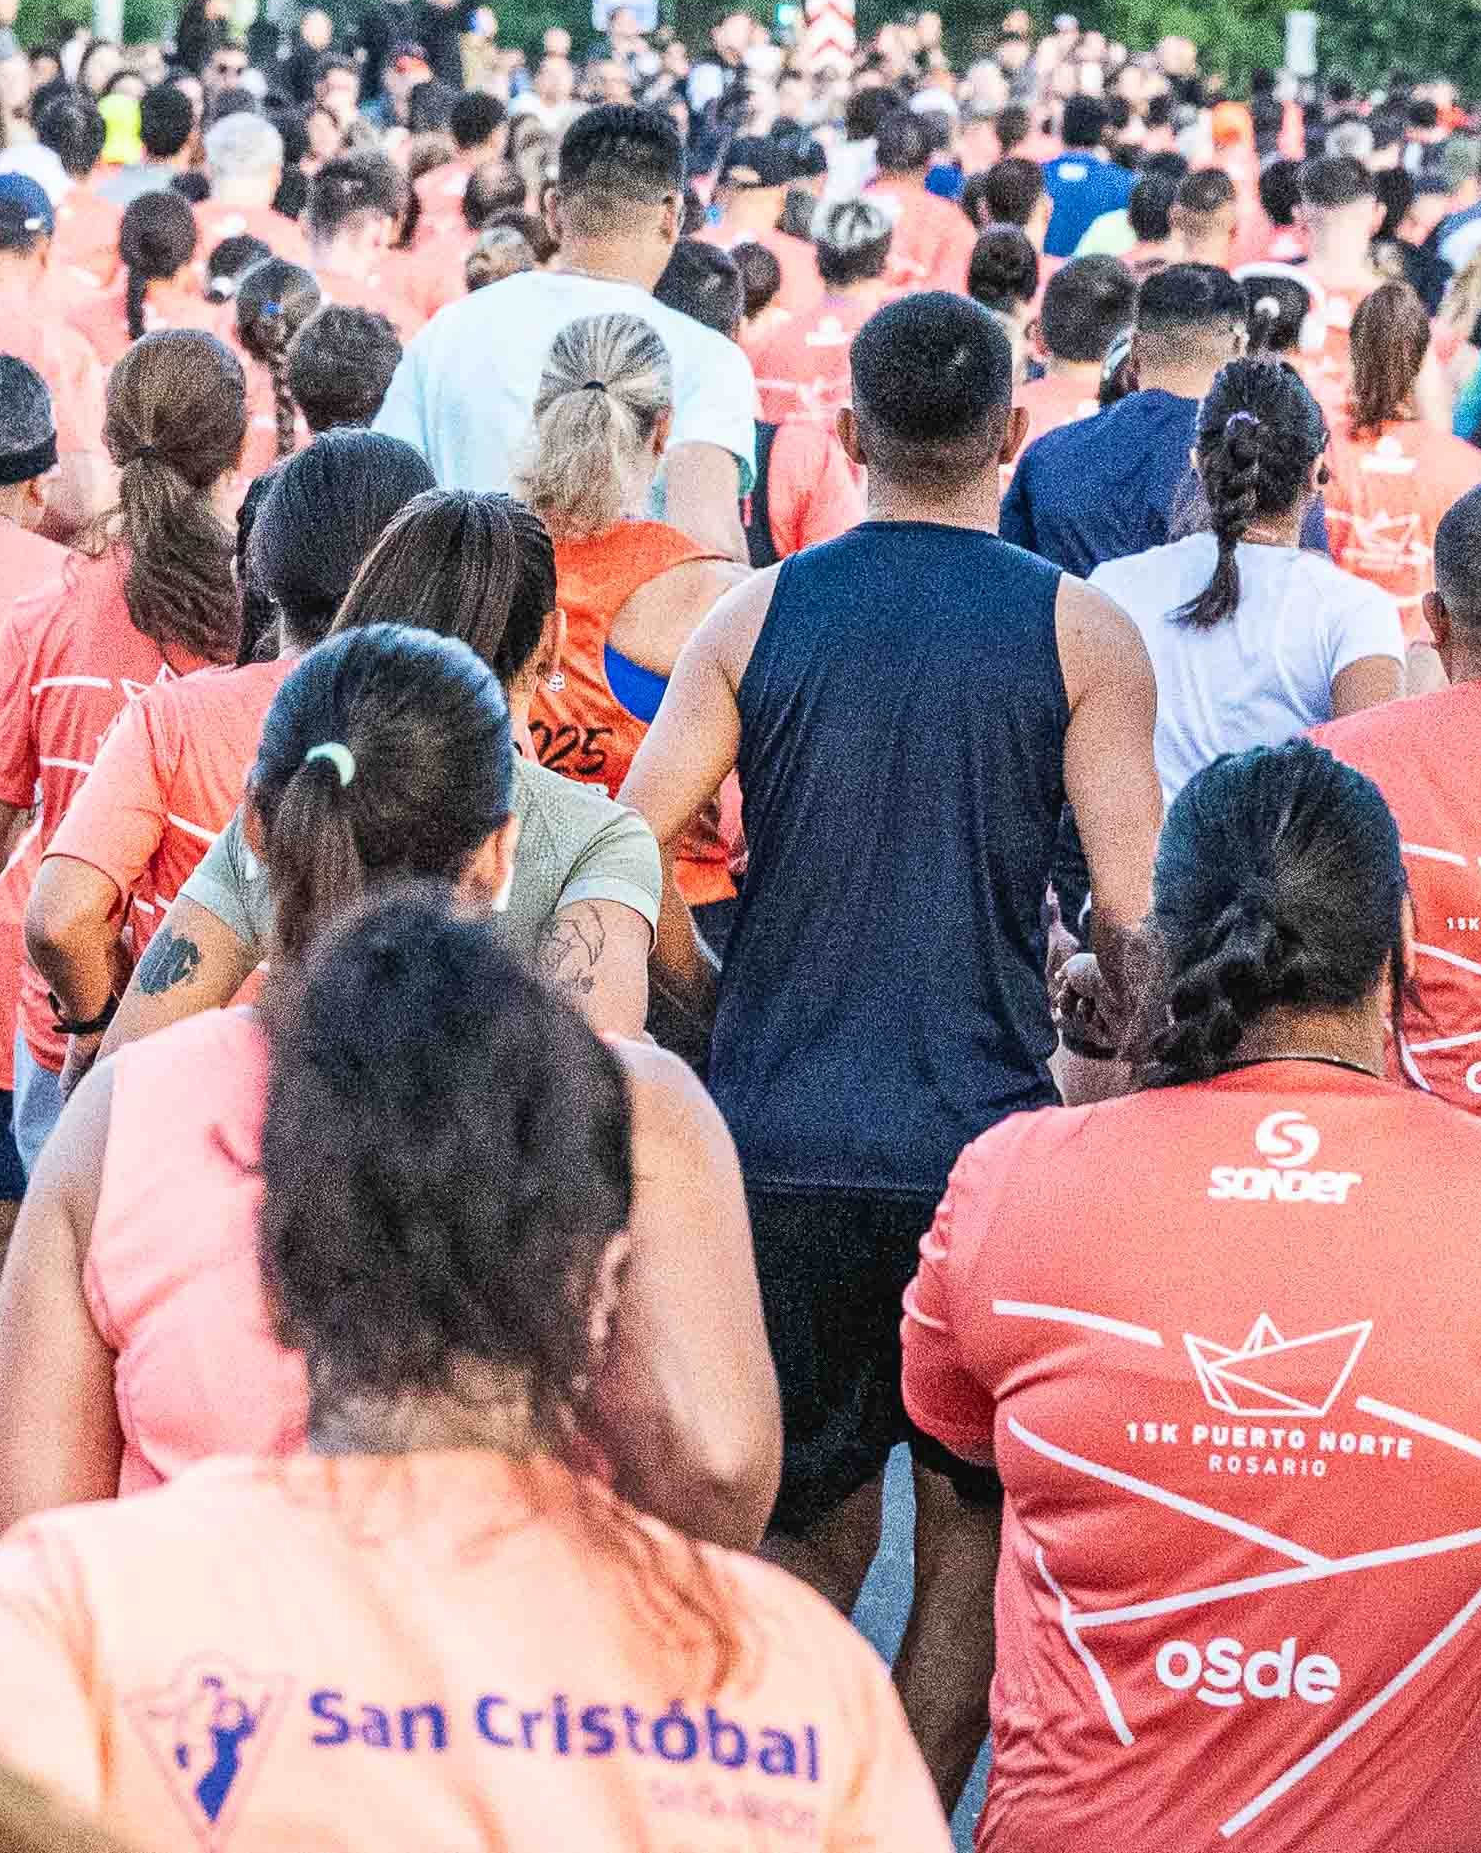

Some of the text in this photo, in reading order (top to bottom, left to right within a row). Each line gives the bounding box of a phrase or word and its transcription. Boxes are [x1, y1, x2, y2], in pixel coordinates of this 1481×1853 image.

[1127, 1422, 1413, 1460] 15K PUERTO NORTE
[1209, 1454, 1326, 1477] ROSARIO
[1155, 1636, 1341, 1706] osde
[309, 1688, 820, 1783] San Cristóbal
